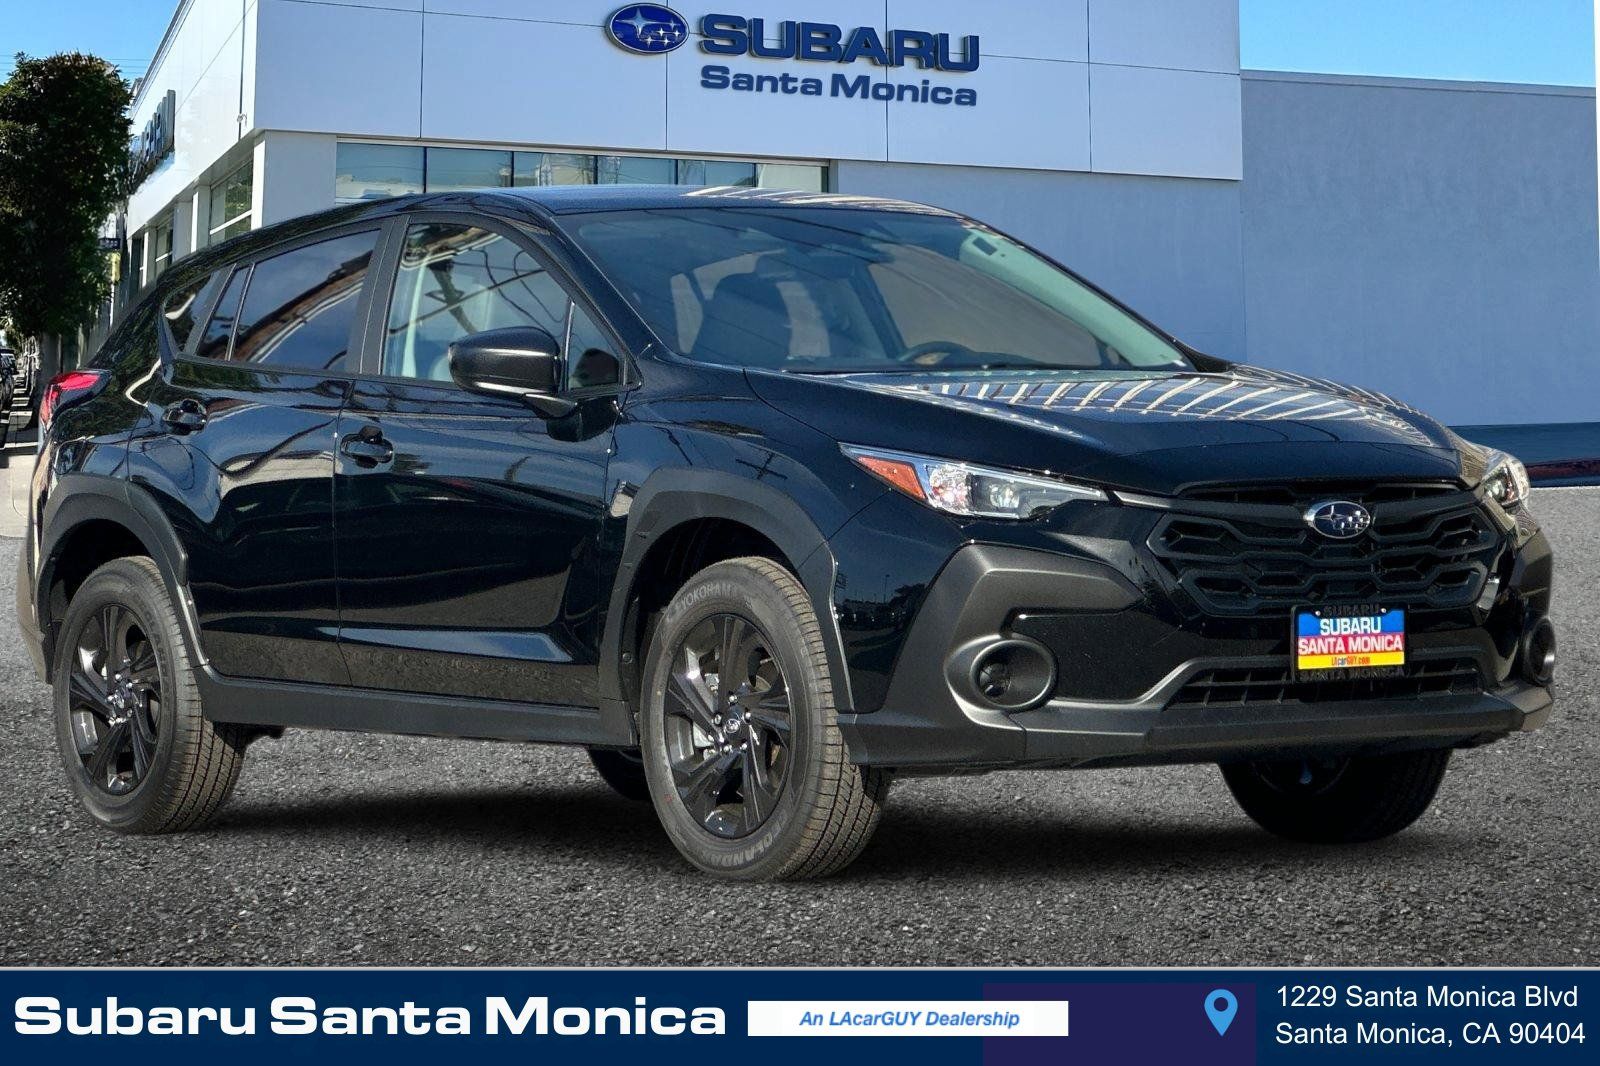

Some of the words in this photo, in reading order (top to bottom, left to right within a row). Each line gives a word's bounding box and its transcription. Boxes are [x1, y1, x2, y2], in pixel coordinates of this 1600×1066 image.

[699, 13, 980, 72] SUBARU
[700, 65, 822, 96] Santa
[830, 73, 977, 106] Monica
[1323, 603, 1380, 616] SUBARU
[1320, 617, 1381, 635] SUBARU
[1298, 637, 1346, 654] SANTA
[1349, 635, 1403, 653] MONICA
